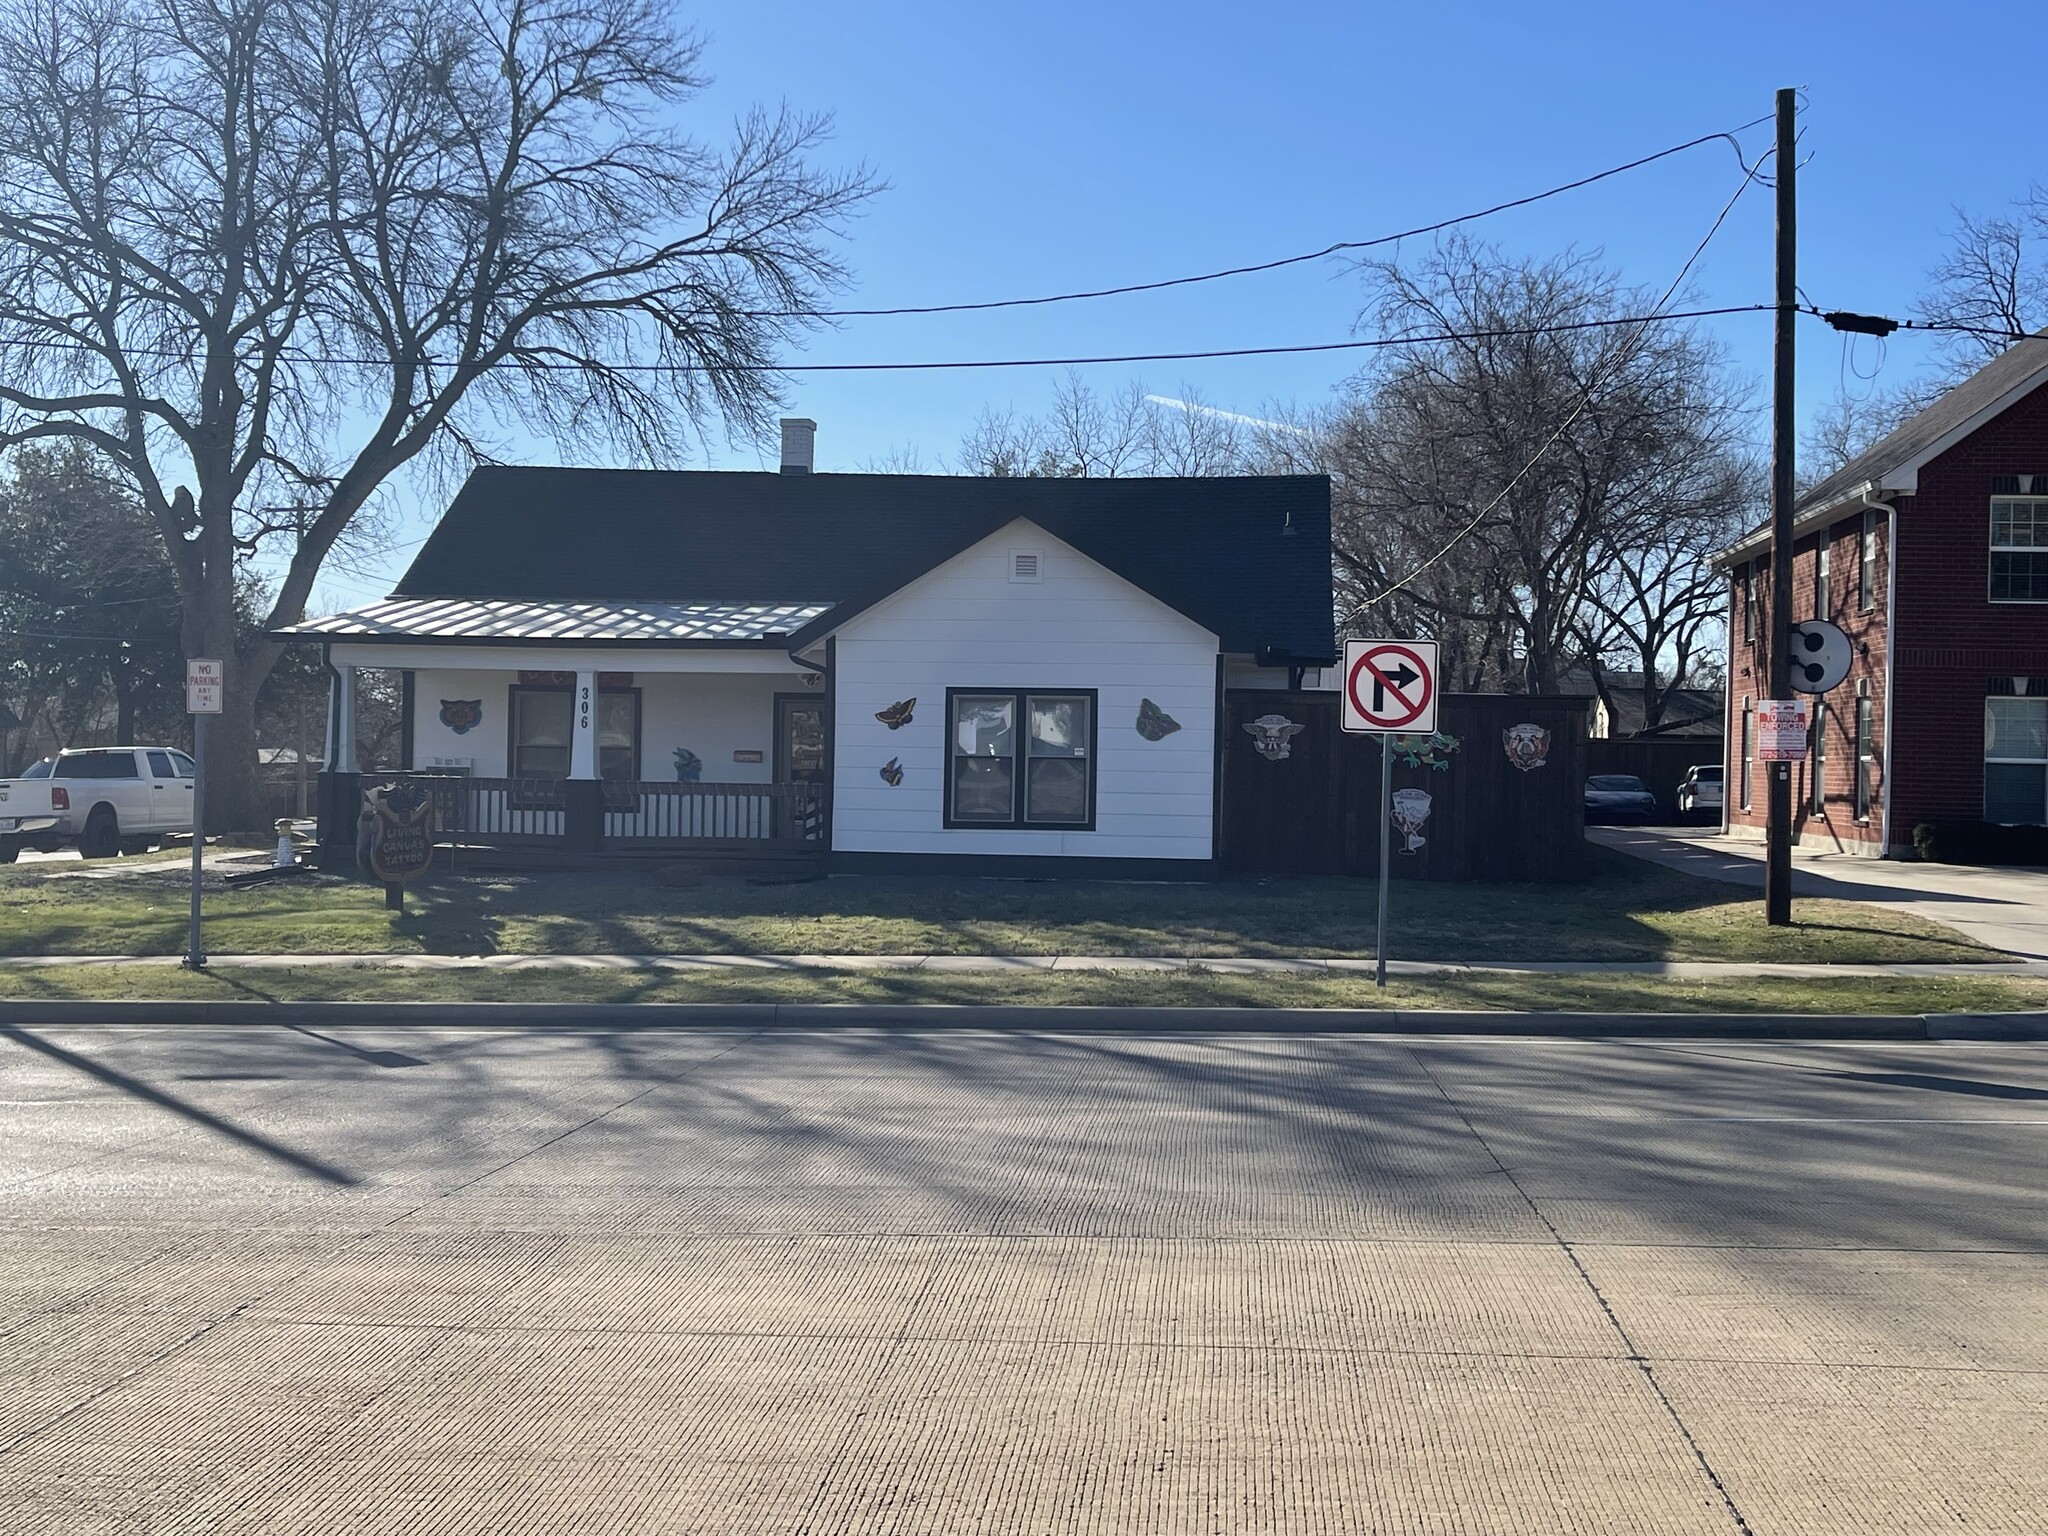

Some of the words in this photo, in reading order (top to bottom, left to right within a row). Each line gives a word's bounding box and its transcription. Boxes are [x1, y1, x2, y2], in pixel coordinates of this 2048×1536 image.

[198, 664, 212, 675] NO
[190, 675, 220, 687] PARKING
[197, 694, 213, 702] TIME
[581, 687, 589, 729] 306
[1765, 712, 1799, 722] TOWING
[1760, 721, 1805, 731] ENFORCED
[386, 826, 422, 840] LIVING
[384, 851, 424, 866] TATTOO
